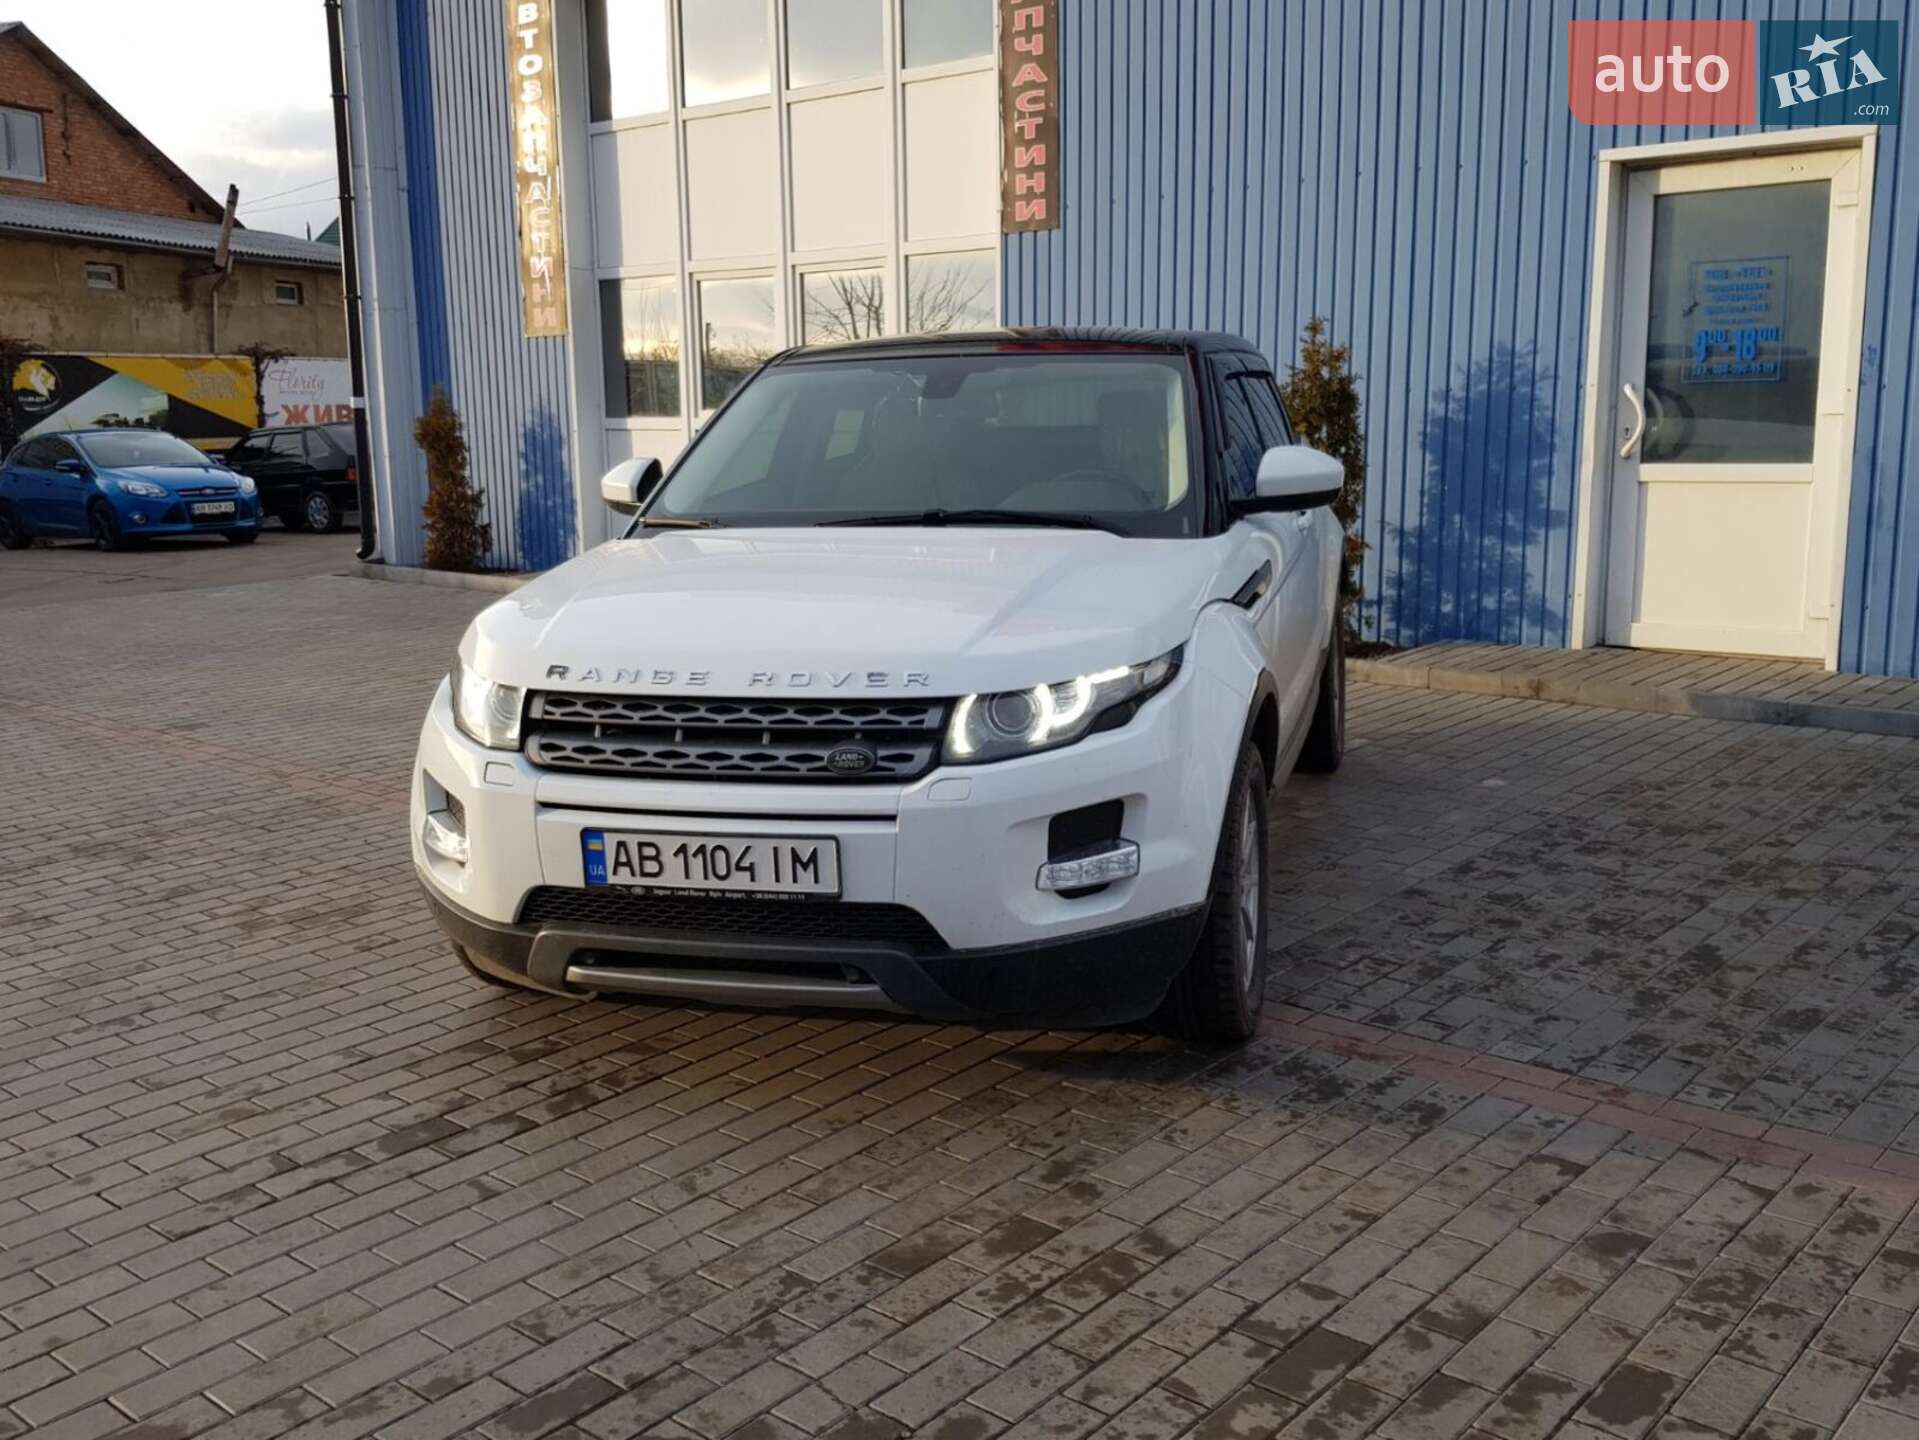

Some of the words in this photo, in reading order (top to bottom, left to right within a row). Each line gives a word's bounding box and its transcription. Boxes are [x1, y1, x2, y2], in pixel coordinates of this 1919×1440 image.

[1010, 0, 1048, 222] ПЧАСТИНИ
[545, 664, 711, 688] RANGE
[748, 670, 931, 688] ROVER
[588, 864, 606, 877] UA
[612, 840, 664, 878] AB
[672, 843, 756, 882] 1104
[772, 846, 820, 884] IM
